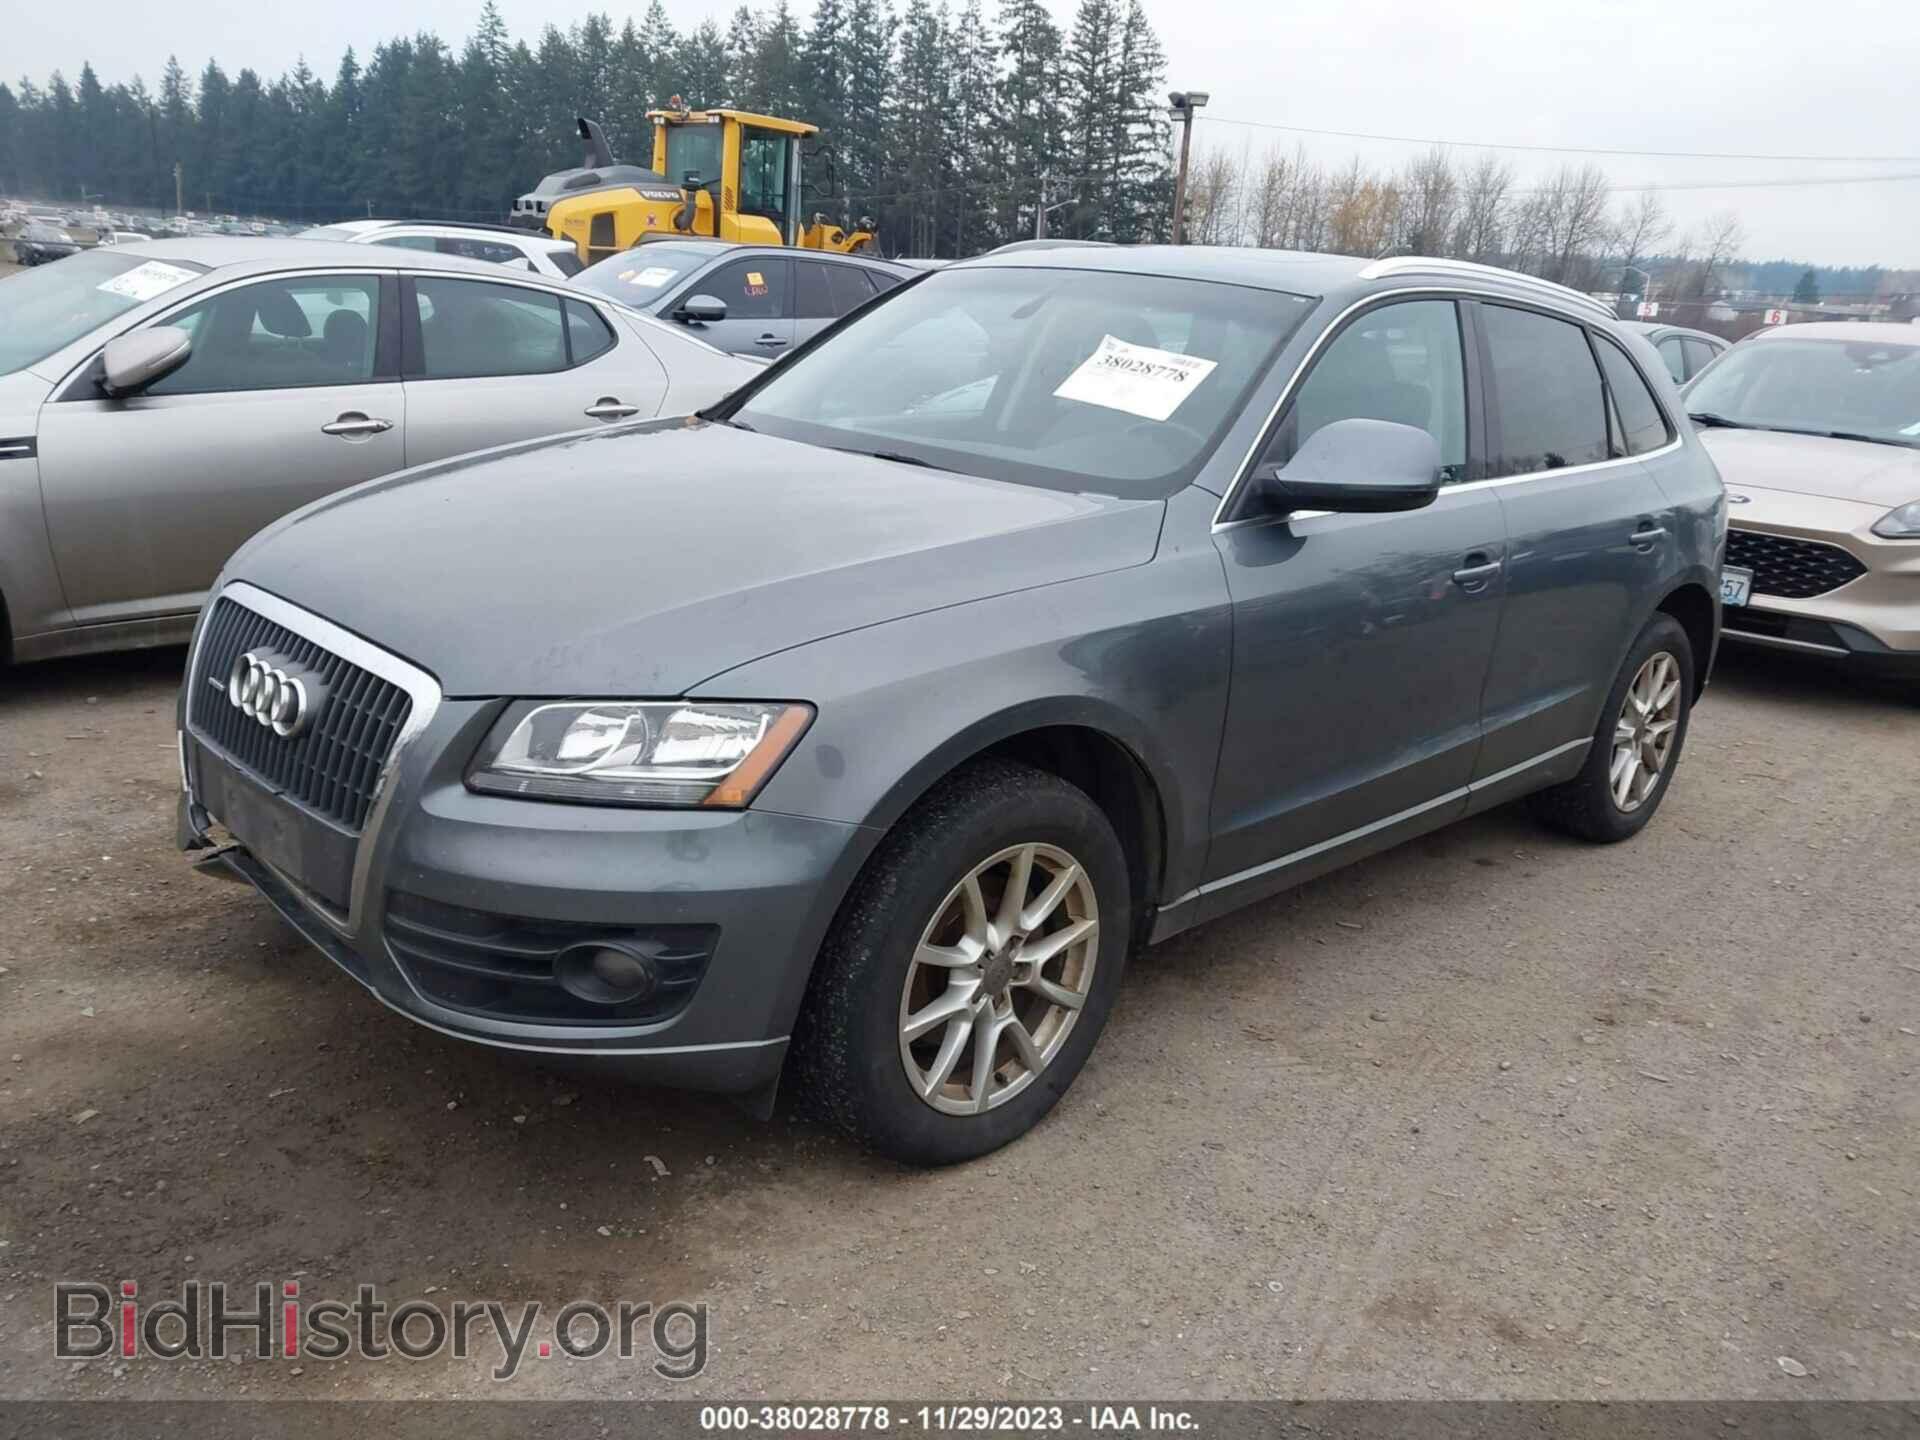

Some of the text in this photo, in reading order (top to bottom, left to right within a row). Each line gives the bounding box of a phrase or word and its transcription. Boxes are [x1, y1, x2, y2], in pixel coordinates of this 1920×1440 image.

[641, 190, 680, 199] VOLVO
[1643, 303, 1652, 315] 5
[1771, 310, 1781, 323] 6
[1097, 354, 1189, 382] 38028778
